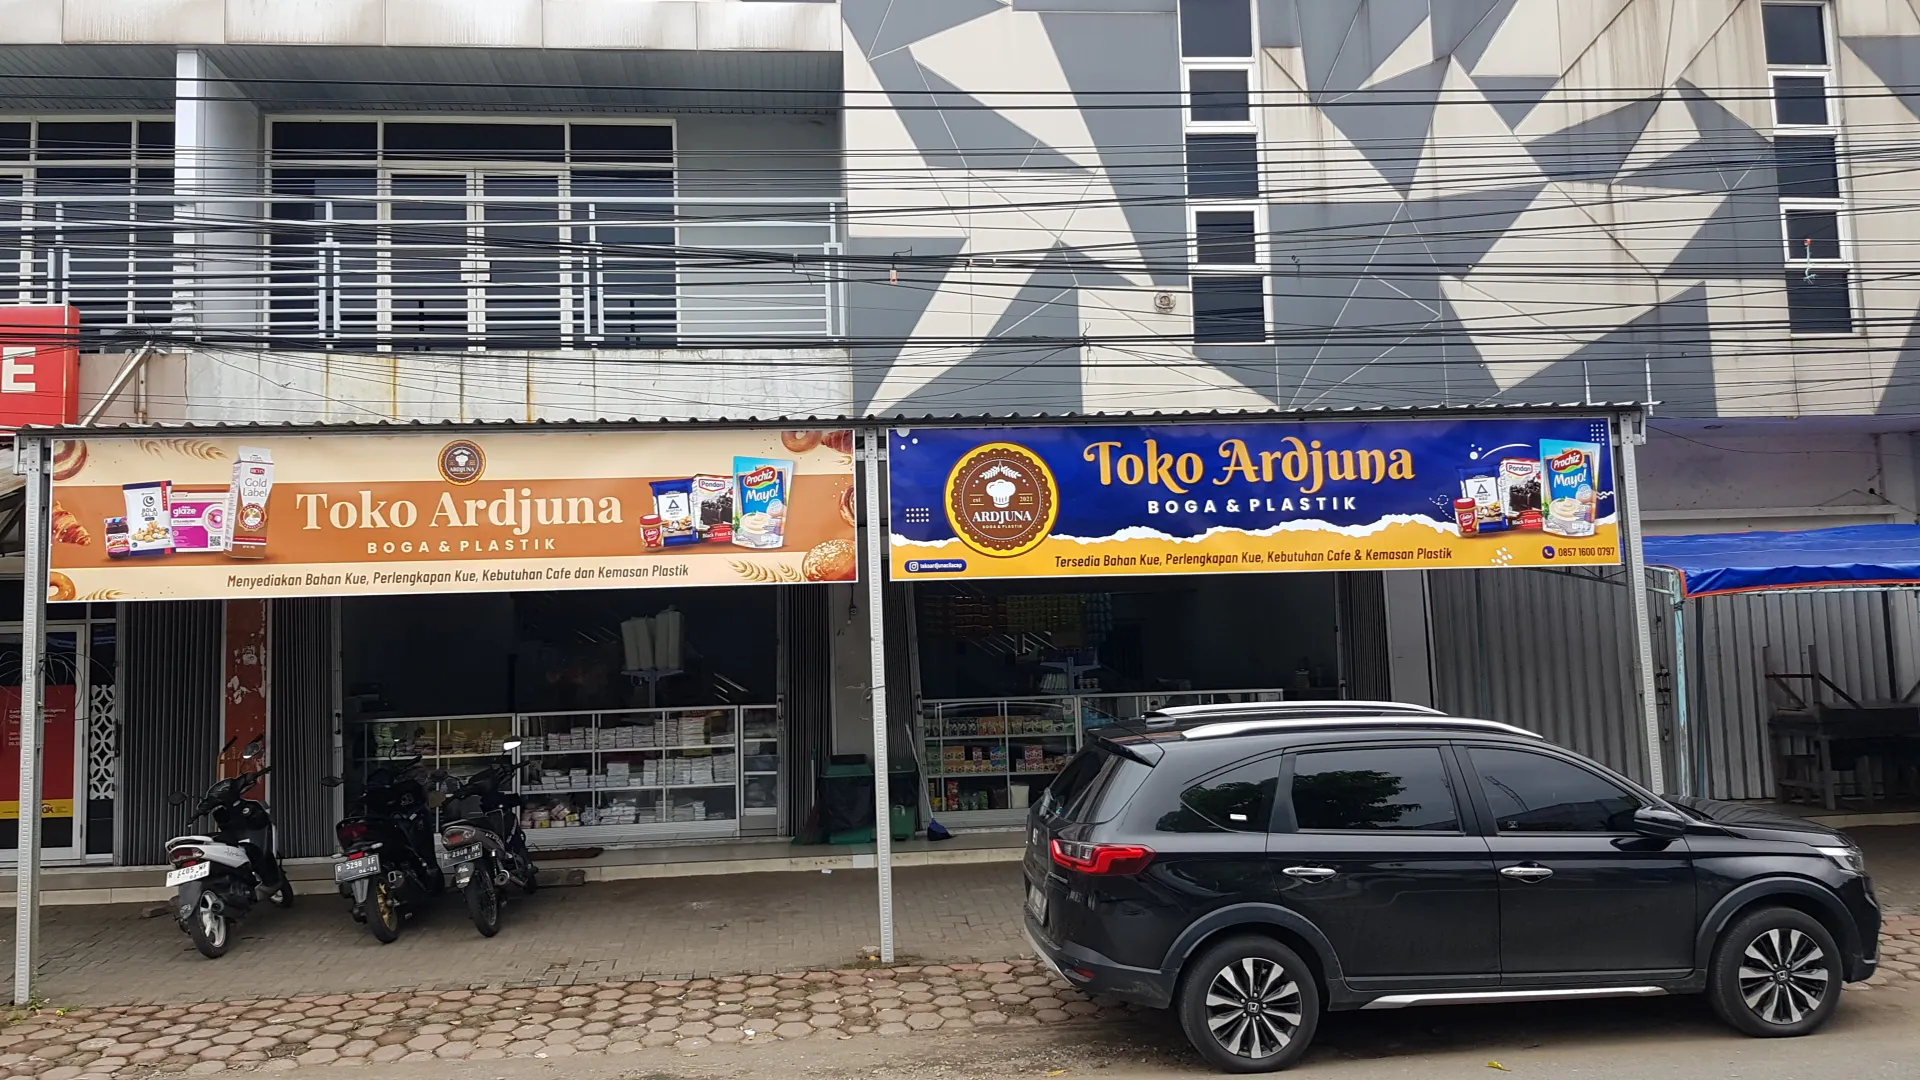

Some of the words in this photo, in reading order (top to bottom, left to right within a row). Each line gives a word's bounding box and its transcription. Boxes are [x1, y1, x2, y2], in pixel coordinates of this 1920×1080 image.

[1083, 438, 1204, 495] Toko
[1212, 436, 1416, 494] Ardjuna
[1553, 452, 1580, 469] Prochiz
[746, 469, 774, 485] Prochiz
[1553, 469, 1587, 488] Mayo!
[243, 488, 267, 497] Label
[745, 484, 779, 503] Mayo!
[173, 507, 196, 517] glaze
[296, 490, 418, 530] Toko
[429, 488, 623, 536] Ardjuna
[1148, 499, 1217, 514] BOGA
[1226, 499, 1240, 513] &
[1249, 496, 1356, 512] PLASTIK
[972, 510, 1032, 524] ARDJUNA
[367, 541, 430, 554] BOGA
[439, 541, 451, 553] &
[460, 538, 556, 552] PLASTIK
[1558, 548, 1576, 557] 0857
[1578, 548, 1596, 556] 1600
[1597, 547, 1615, 556] 0797
[1055, 555, 1100, 568] Tersedia
[1103, 554, 1137, 566] Bahan
[1139, 554, 1162, 566] Kue,
[1165, 552, 1238, 567] Perlengkapan
[1241, 552, 1264, 564] Kue,
[1267, 550, 1324, 563] Kebutuhan
[1326, 549, 1351, 562] Cafe
[1354, 550, 1362, 561] &
[1365, 548, 1414, 561] Kemasan
[1417, 547, 1452, 560] Plastik
[227, 574, 302, 590] Menyediakan
[305, 573, 341, 586] Bahan
[344, 572, 369, 586] Kue,
[373, 570, 451, 586] Perlengkapan
[454, 569, 479, 583] Kue,
[482, 567, 543, 581] Kebutuhan
[546, 567, 571, 580] Cafe
[574, 566, 595, 579] dan
[598, 565, 649, 579] Kemasan
[651, 564, 689, 577] Plastik
[337, 865, 342, 873] R
